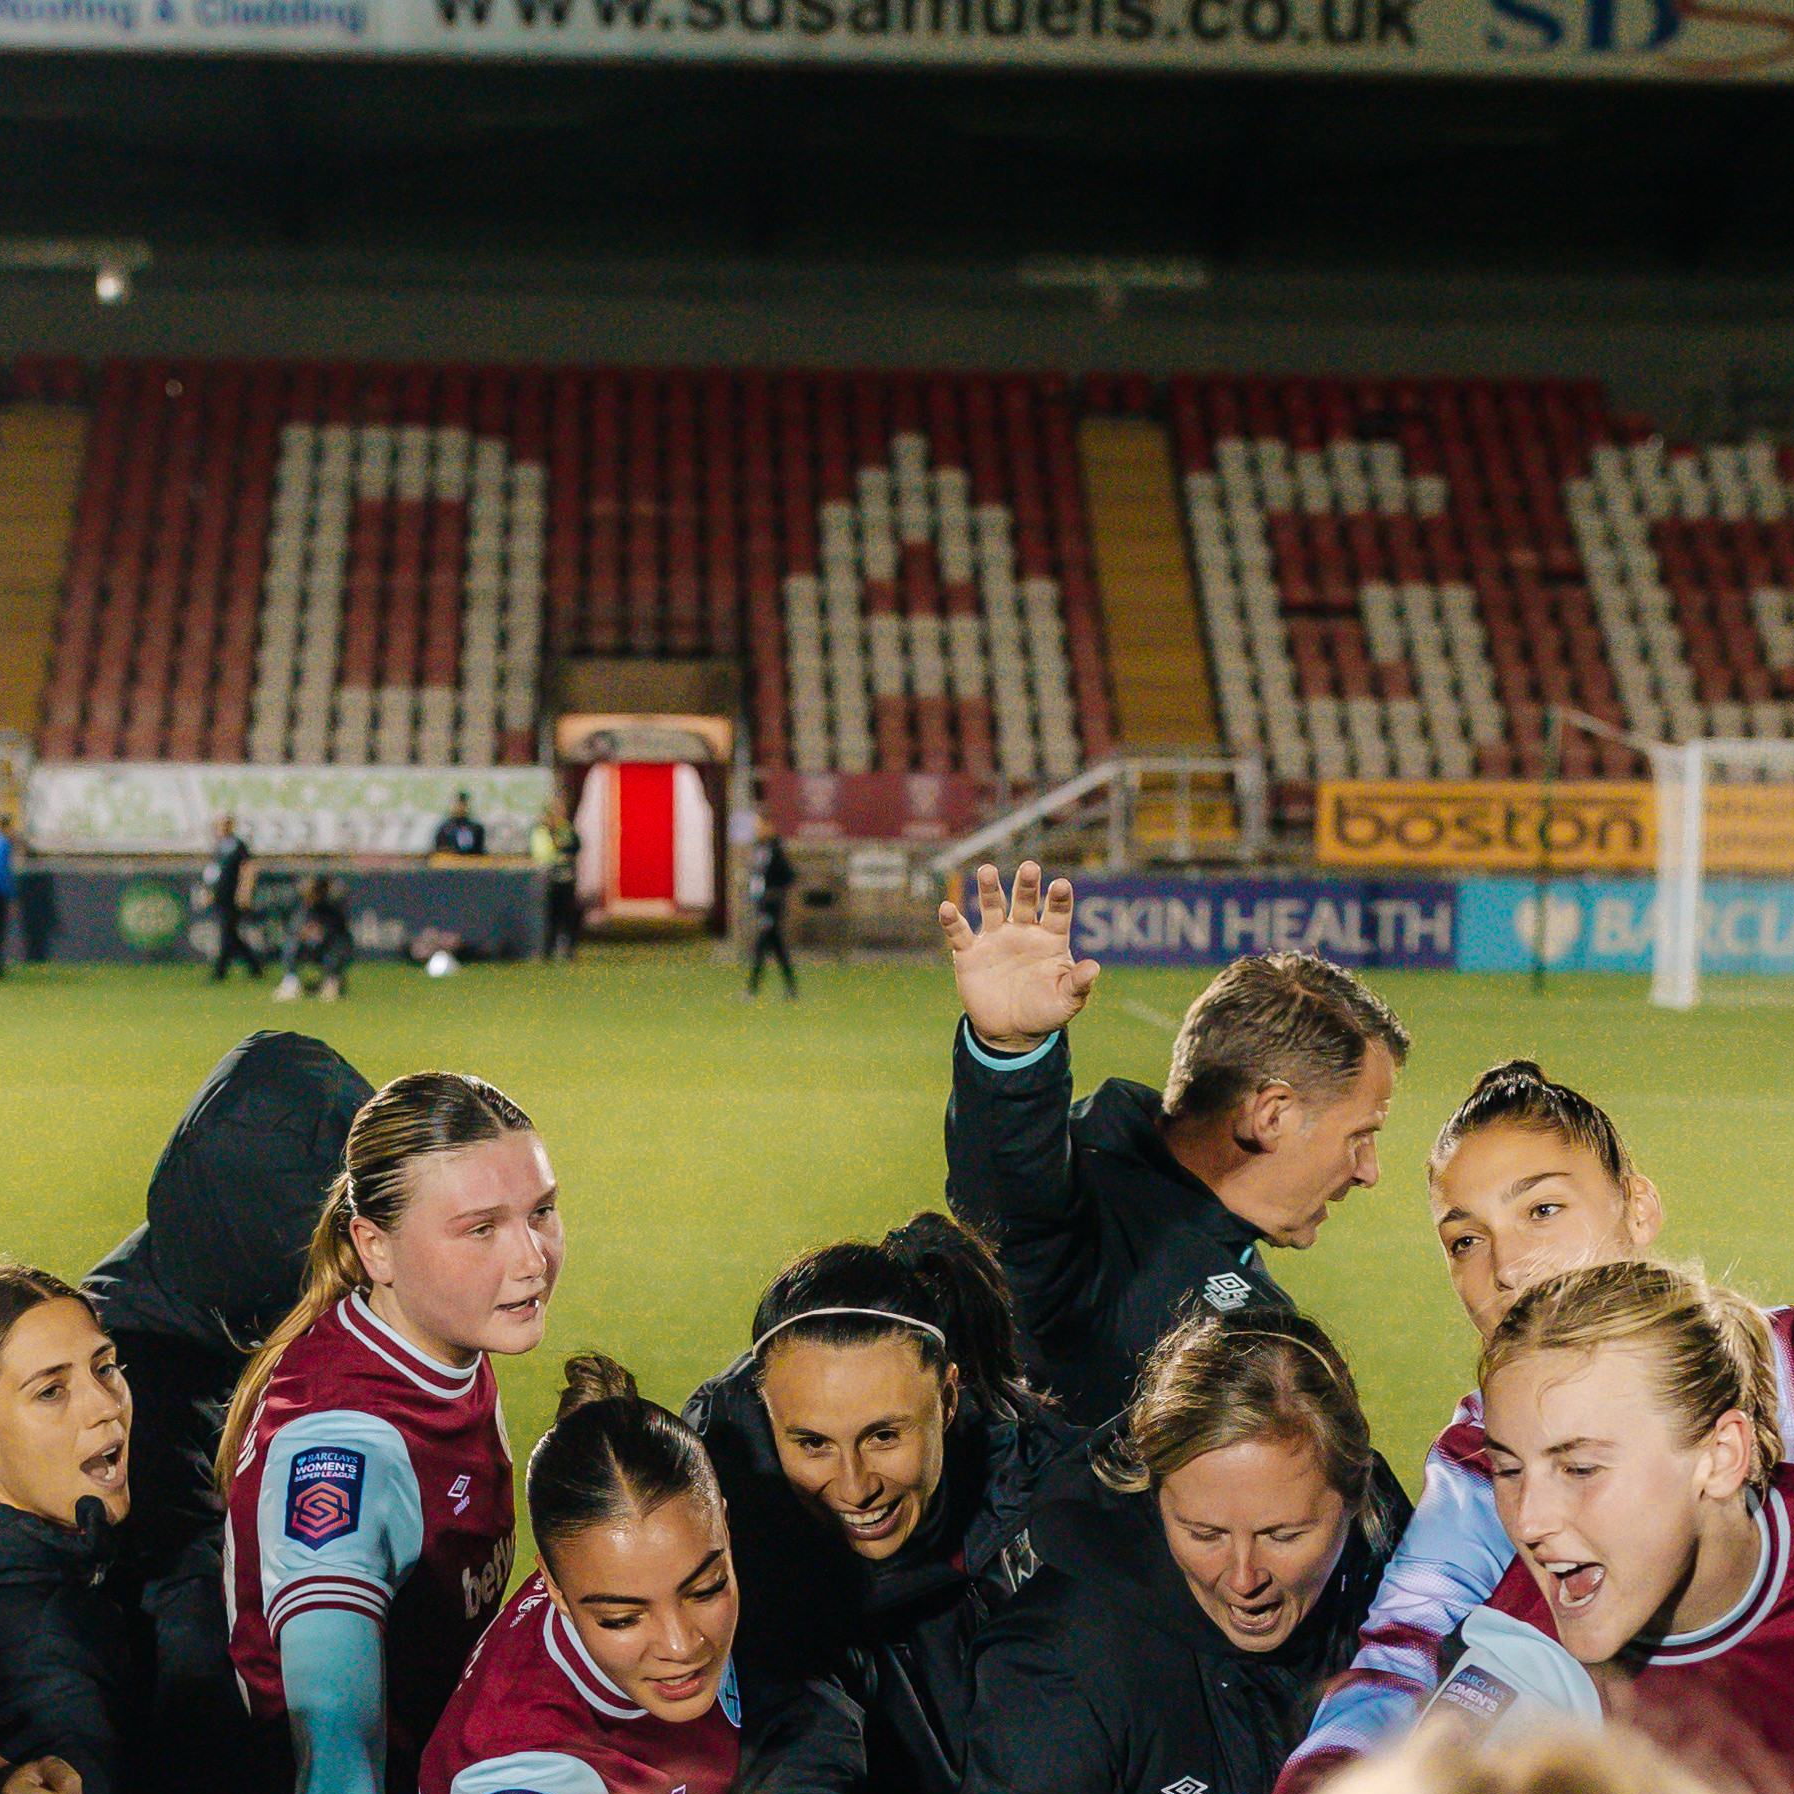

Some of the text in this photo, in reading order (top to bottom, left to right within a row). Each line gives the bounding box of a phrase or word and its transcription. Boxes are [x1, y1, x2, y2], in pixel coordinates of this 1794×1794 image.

[1332, 797, 1646, 852] boston
[1078, 897, 1453, 954] SKIN HEALTH
[307, 1452, 358, 1464] BARCLAYS
[295, 1462, 357, 1475] WOMEN'S
[294, 1471, 357, 1482] SUPER LEAGUE
